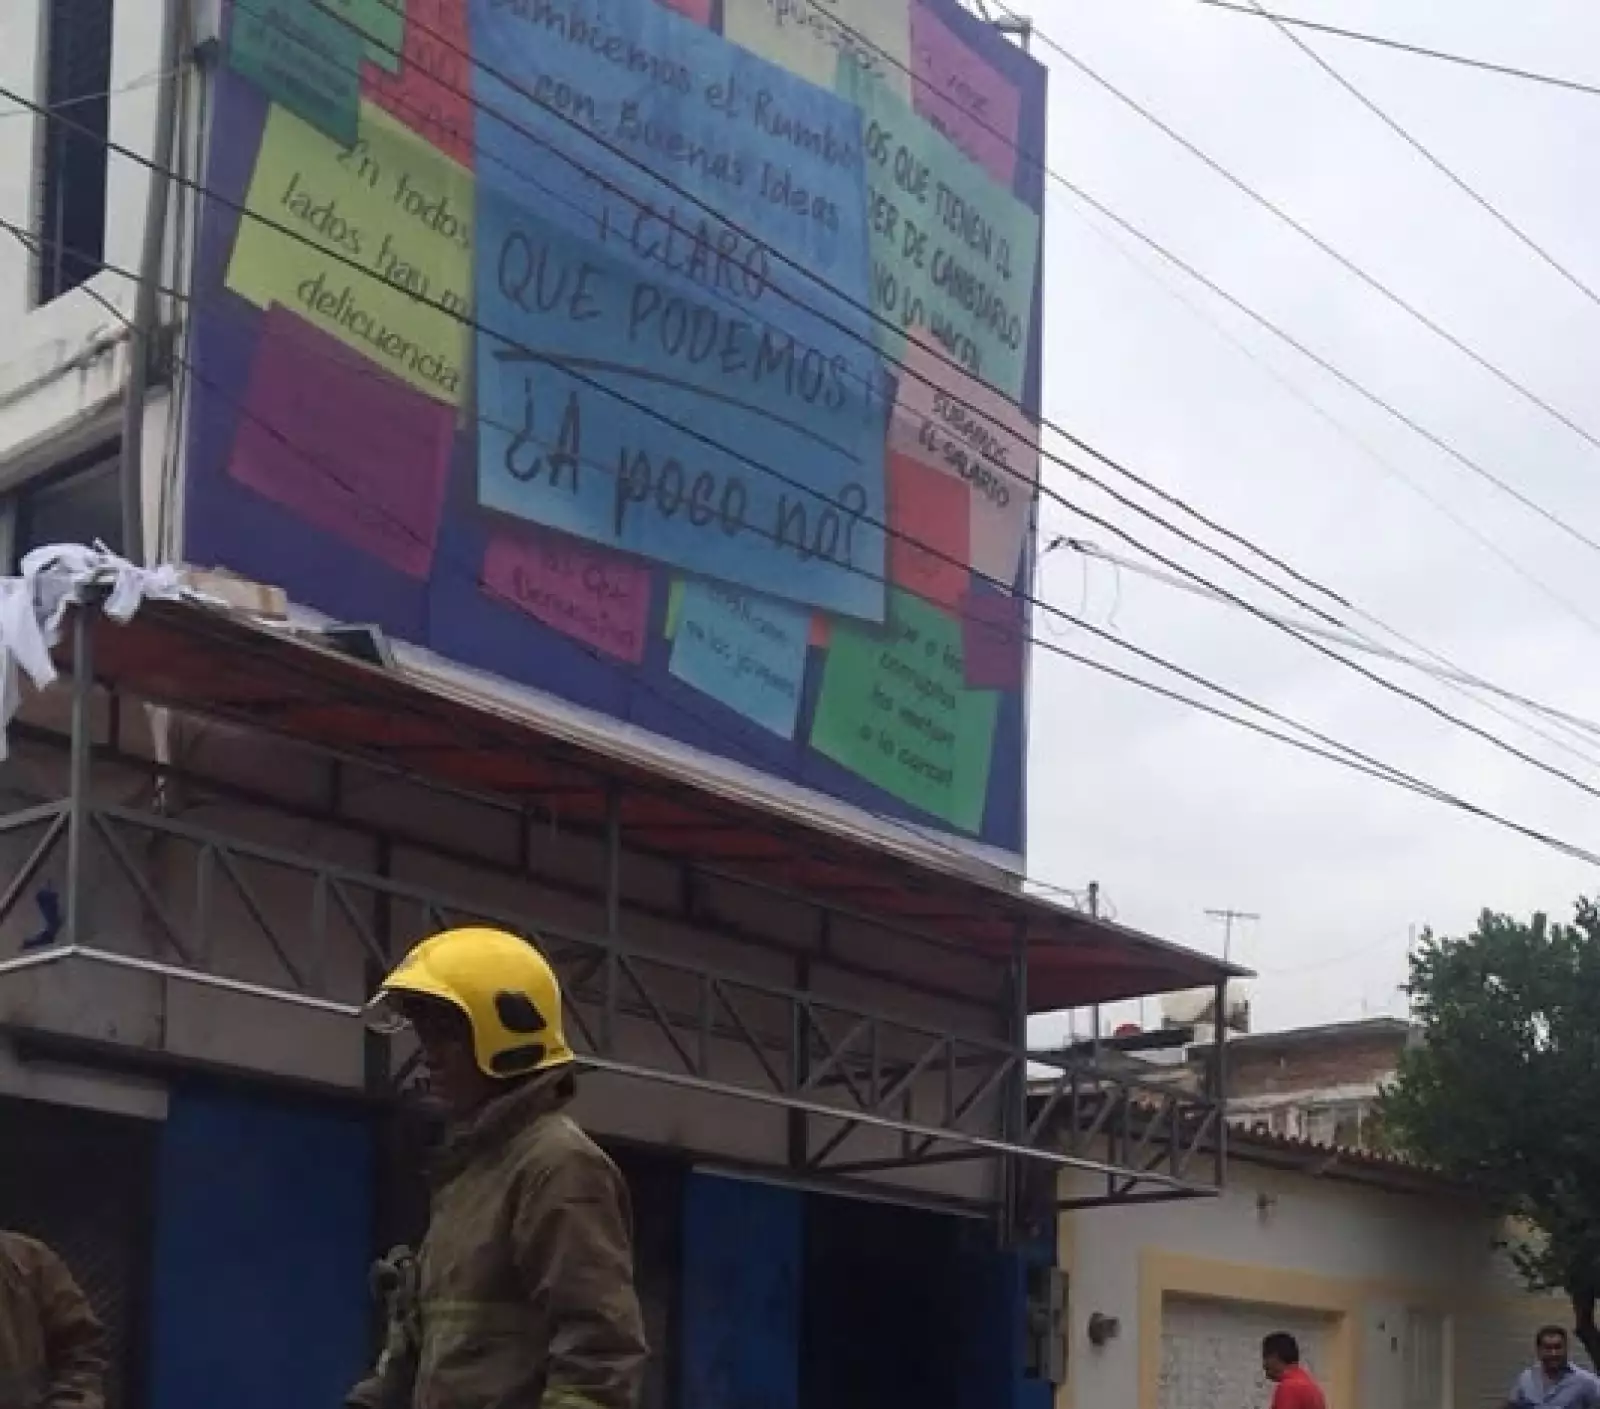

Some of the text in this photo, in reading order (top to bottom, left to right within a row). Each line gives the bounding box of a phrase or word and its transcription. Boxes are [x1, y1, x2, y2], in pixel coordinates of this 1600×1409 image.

[488, 0, 690, 94] ambiemos
[704, 74, 739, 118] el
[534, 74, 596, 128] con
[617, 98, 743, 188] Buenas
[760, 162, 840, 234] Ideas
[894, 144, 930, 205] QUE
[280, 172, 364, 256] lados
[396, 172, 472, 252] todos
[902, 219, 929, 270] DE
[498, 229, 602, 324] QUE
[297, 270, 462, 394] delicuencia
[776, 481, 869, 570] no?
